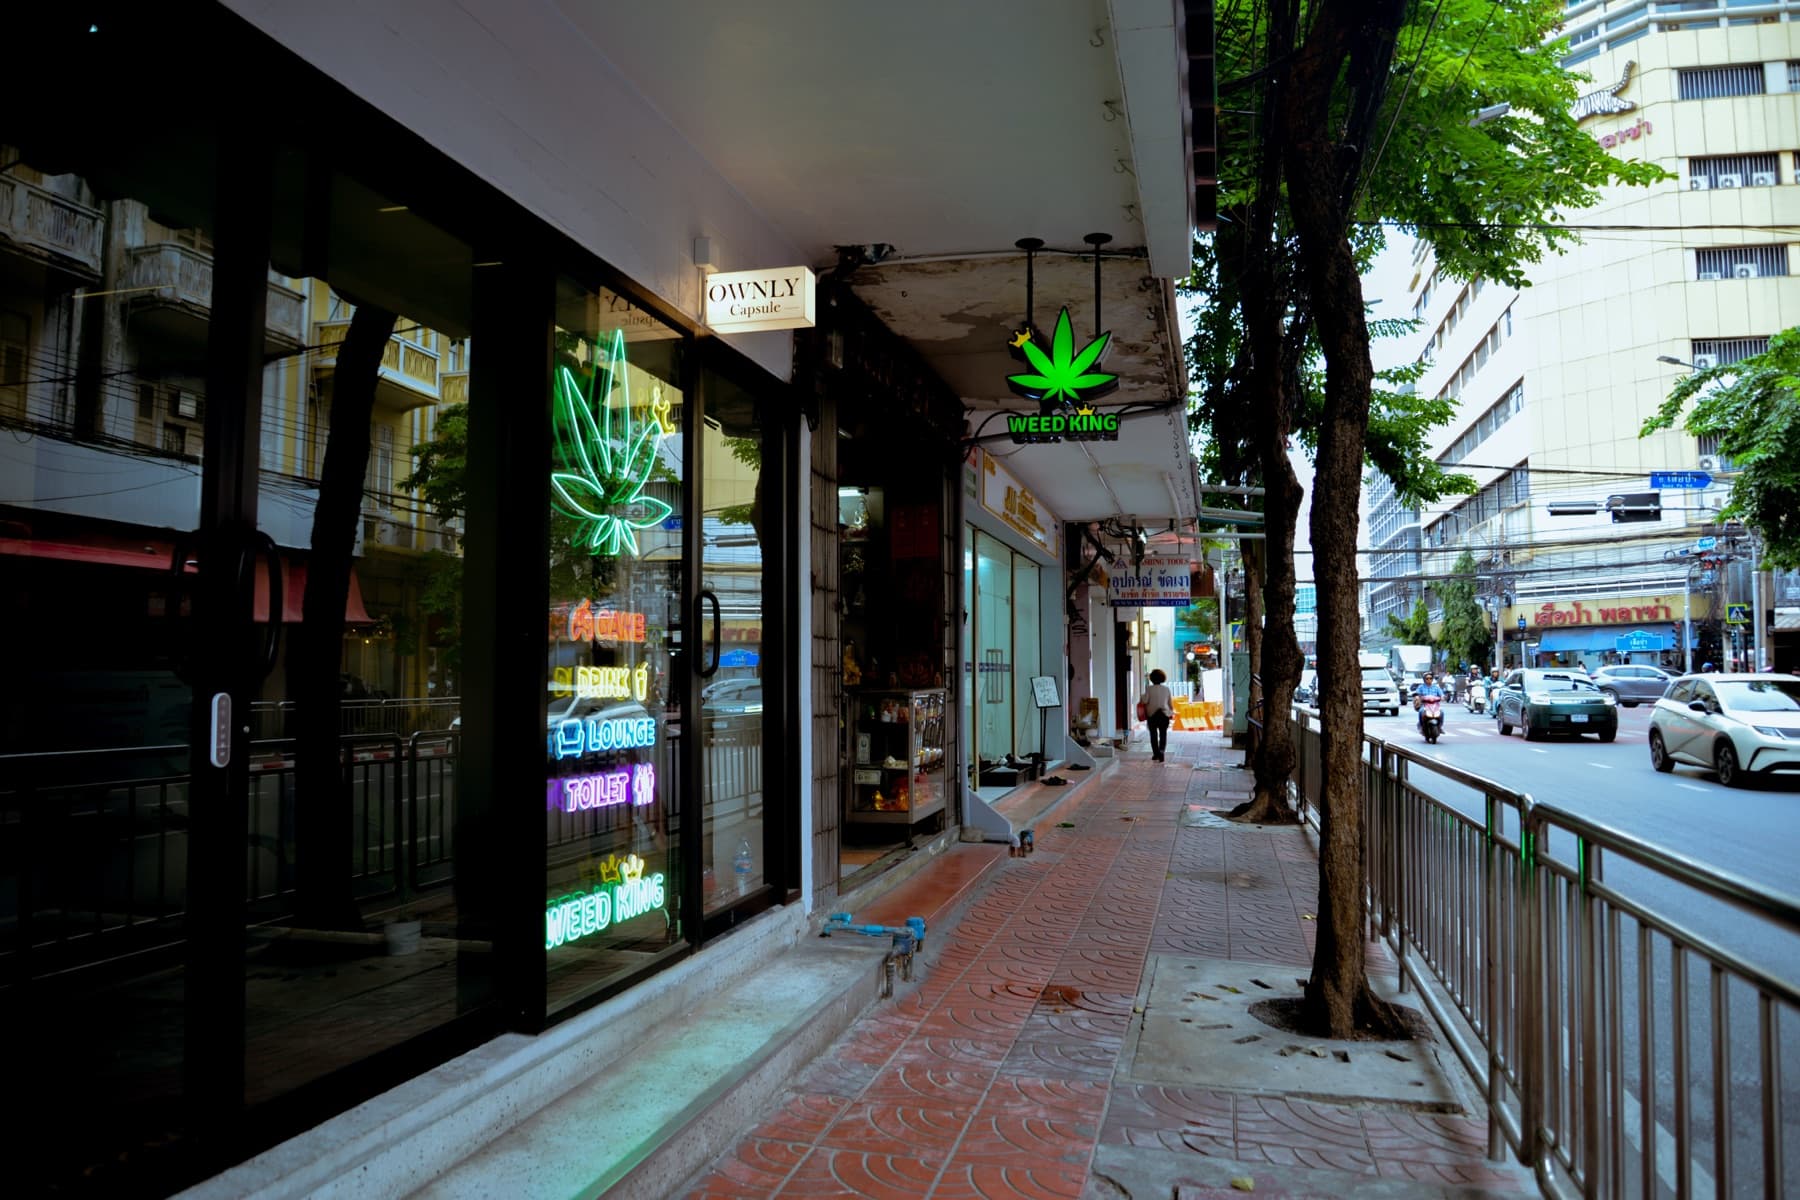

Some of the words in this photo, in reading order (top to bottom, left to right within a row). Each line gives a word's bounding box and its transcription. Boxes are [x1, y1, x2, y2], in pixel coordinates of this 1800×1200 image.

[1597, 118, 1653, 149] ลาซ่า
[709, 278, 800, 302] OWNLY
[730, 301, 781, 318] Capsule
[1009, 416, 1065, 433] WEED
[1069, 414, 1117, 432] KING
[1112, 568, 1153, 595] อุปกรณ์
[1158, 570, 1189, 588] ขัดเงา
[1535, 601, 1592, 626] เสือป่า
[1599, 598, 1672, 624] พลาซ่า
[577, 666, 631, 698] DRINK
[588, 718, 655, 751] LOUNGE
[566, 773, 629, 813] TOILET
[546, 891, 611, 950] WEED
[613, 873, 664, 923] KING
